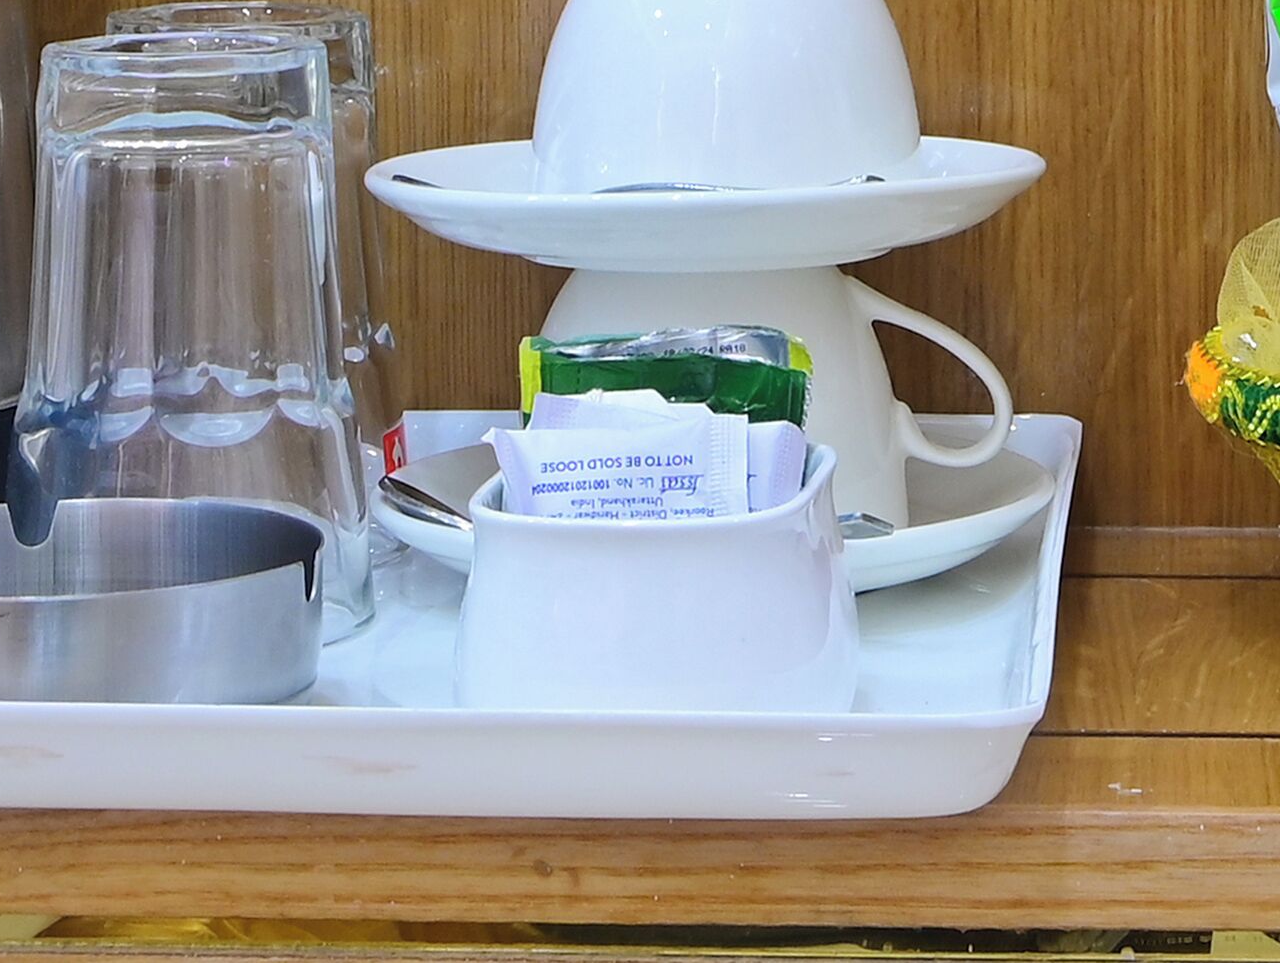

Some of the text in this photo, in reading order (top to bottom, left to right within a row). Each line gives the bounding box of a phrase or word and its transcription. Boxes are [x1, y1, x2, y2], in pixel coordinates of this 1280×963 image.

[540, 454, 693, 474] NOT TO BE SOLD LOOSE
[615, 477, 633, 489] No.
[571, 497, 595, 508] India
[630, 508, 667, 520] District
